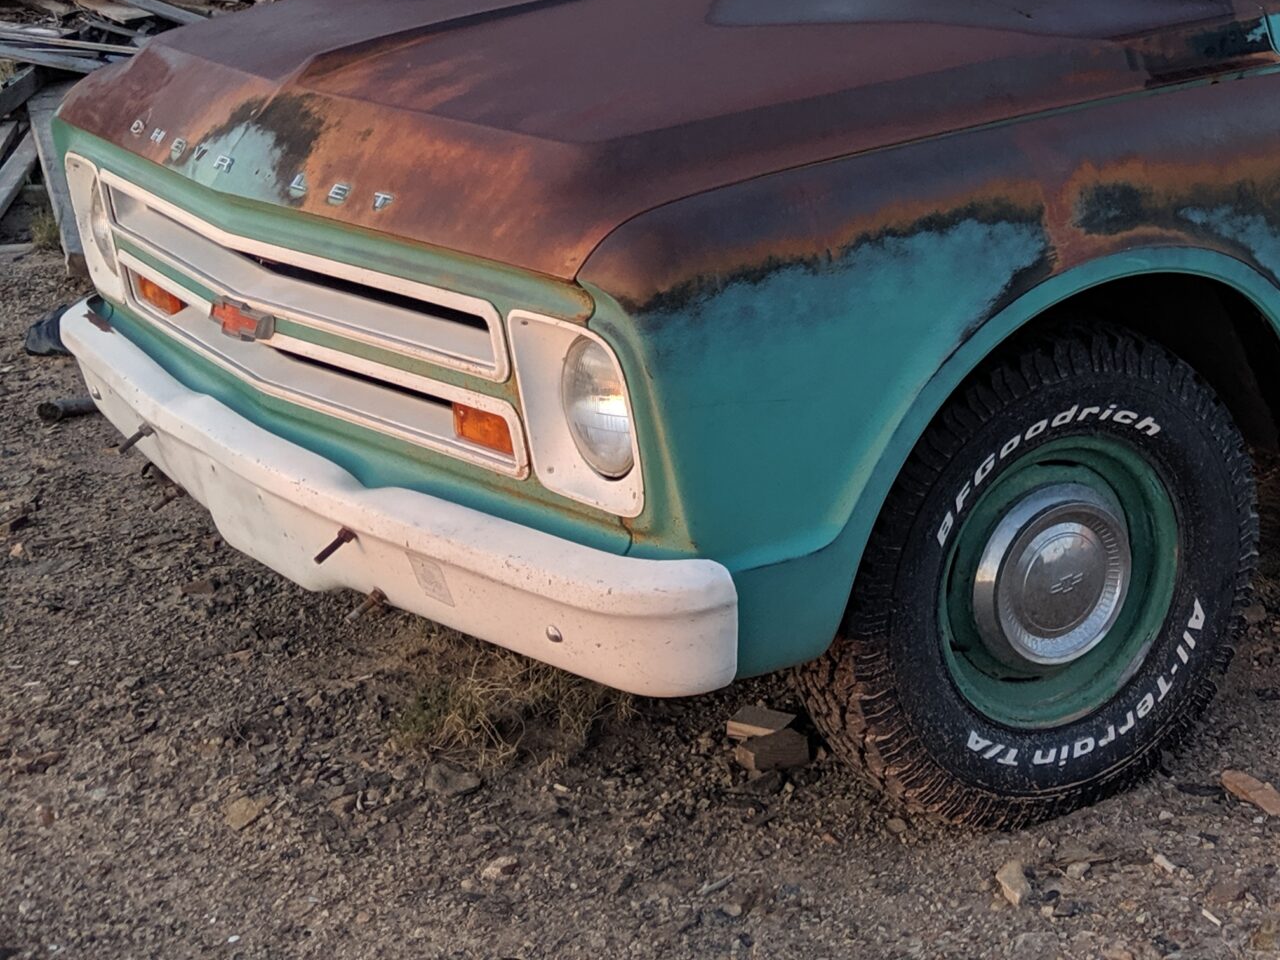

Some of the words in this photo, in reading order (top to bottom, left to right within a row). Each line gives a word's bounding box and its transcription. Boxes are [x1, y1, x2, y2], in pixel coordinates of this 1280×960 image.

[130, 119, 393, 211] CHEVRLET
[937, 404, 1161, 547] BFGoodrich
[1032, 597, 1206, 767] All-Terrain
[966, 730, 1018, 766] T/A
